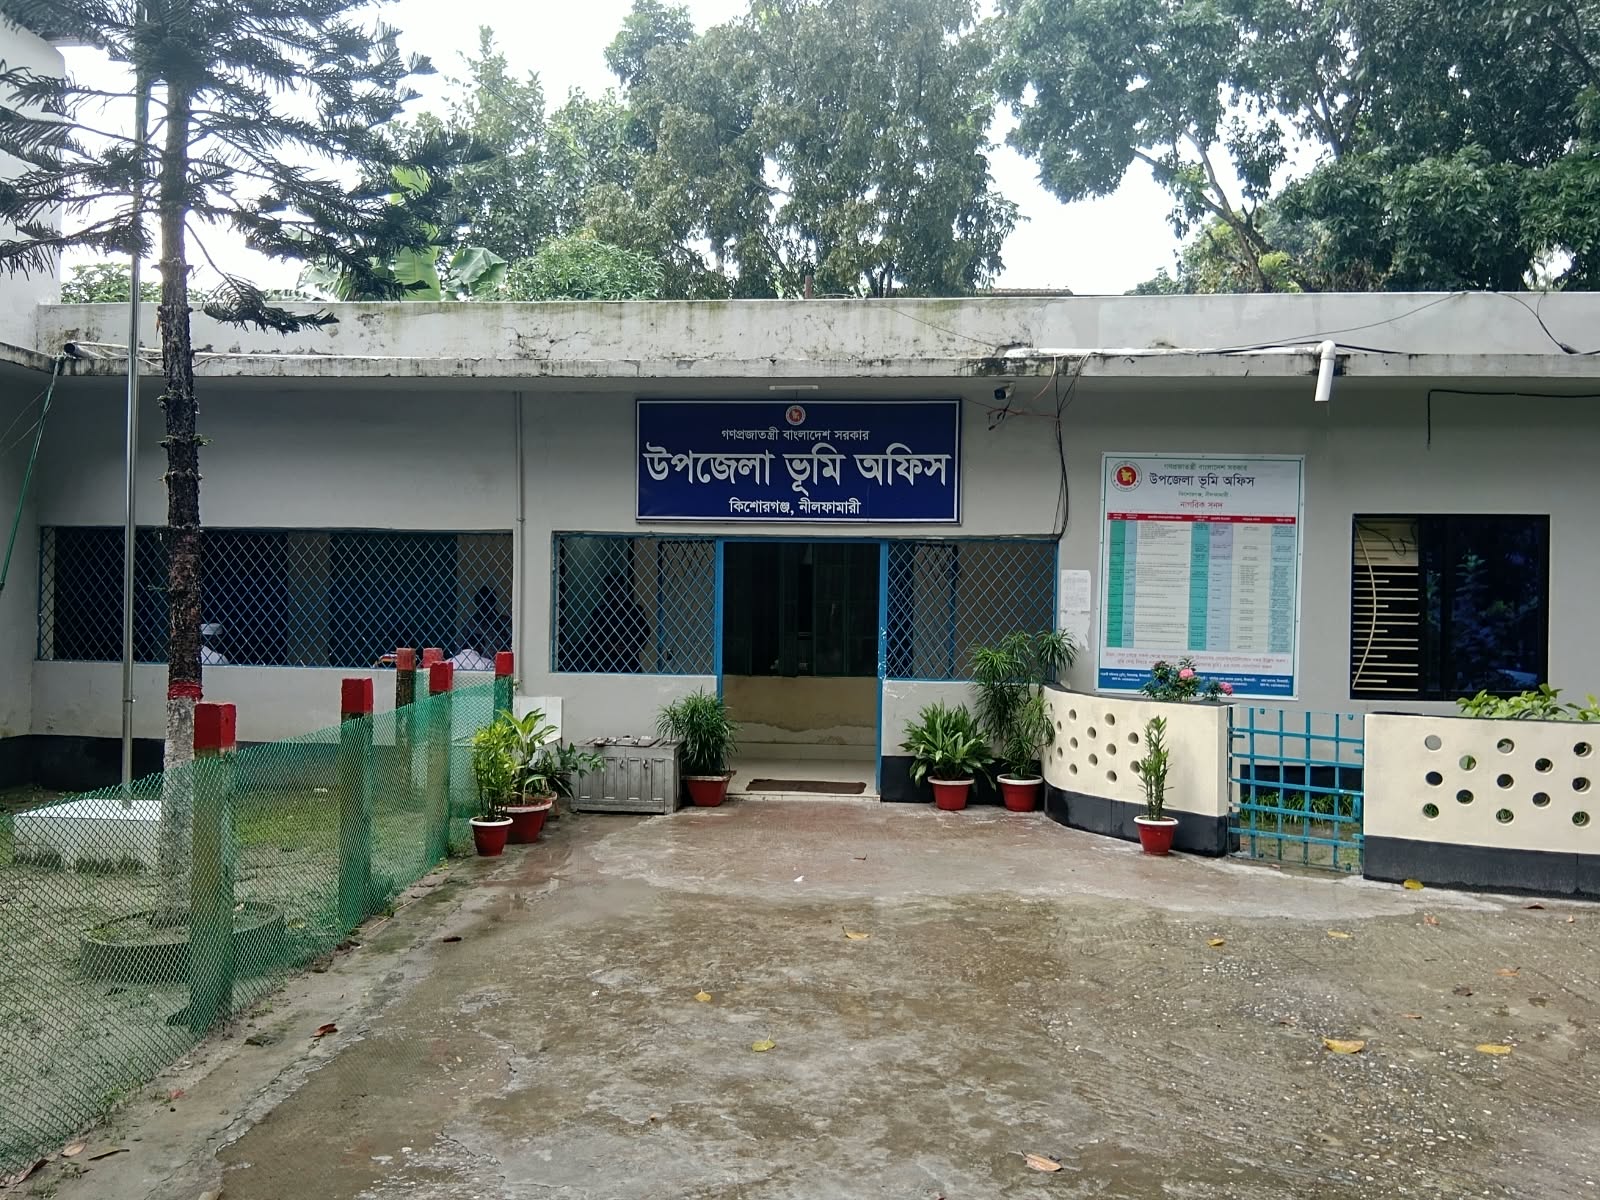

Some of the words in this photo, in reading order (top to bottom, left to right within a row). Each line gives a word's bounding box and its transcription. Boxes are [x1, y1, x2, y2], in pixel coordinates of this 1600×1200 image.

[721, 427, 779, 441] গণপ্রজাতন্ত্রী
[783, 429, 830, 441] বাংলাদেশ
[834, 429, 870, 441] সরকার
[643, 442, 776, 486] উপজেলা
[782, 442, 846, 496] ভূমি
[853, 442, 952, 486] অফিস
[1148, 472, 1194, 487] উপজেলা
[1197, 473, 1220, 489] ভূমি
[1223, 472, 1255, 488] অফিস
[729, 497, 794, 515] কিশোরগঞ্জ,
[799, 497, 861, 515] নীলফামারী
[1180, 499, 1206, 509] নাগরিক
